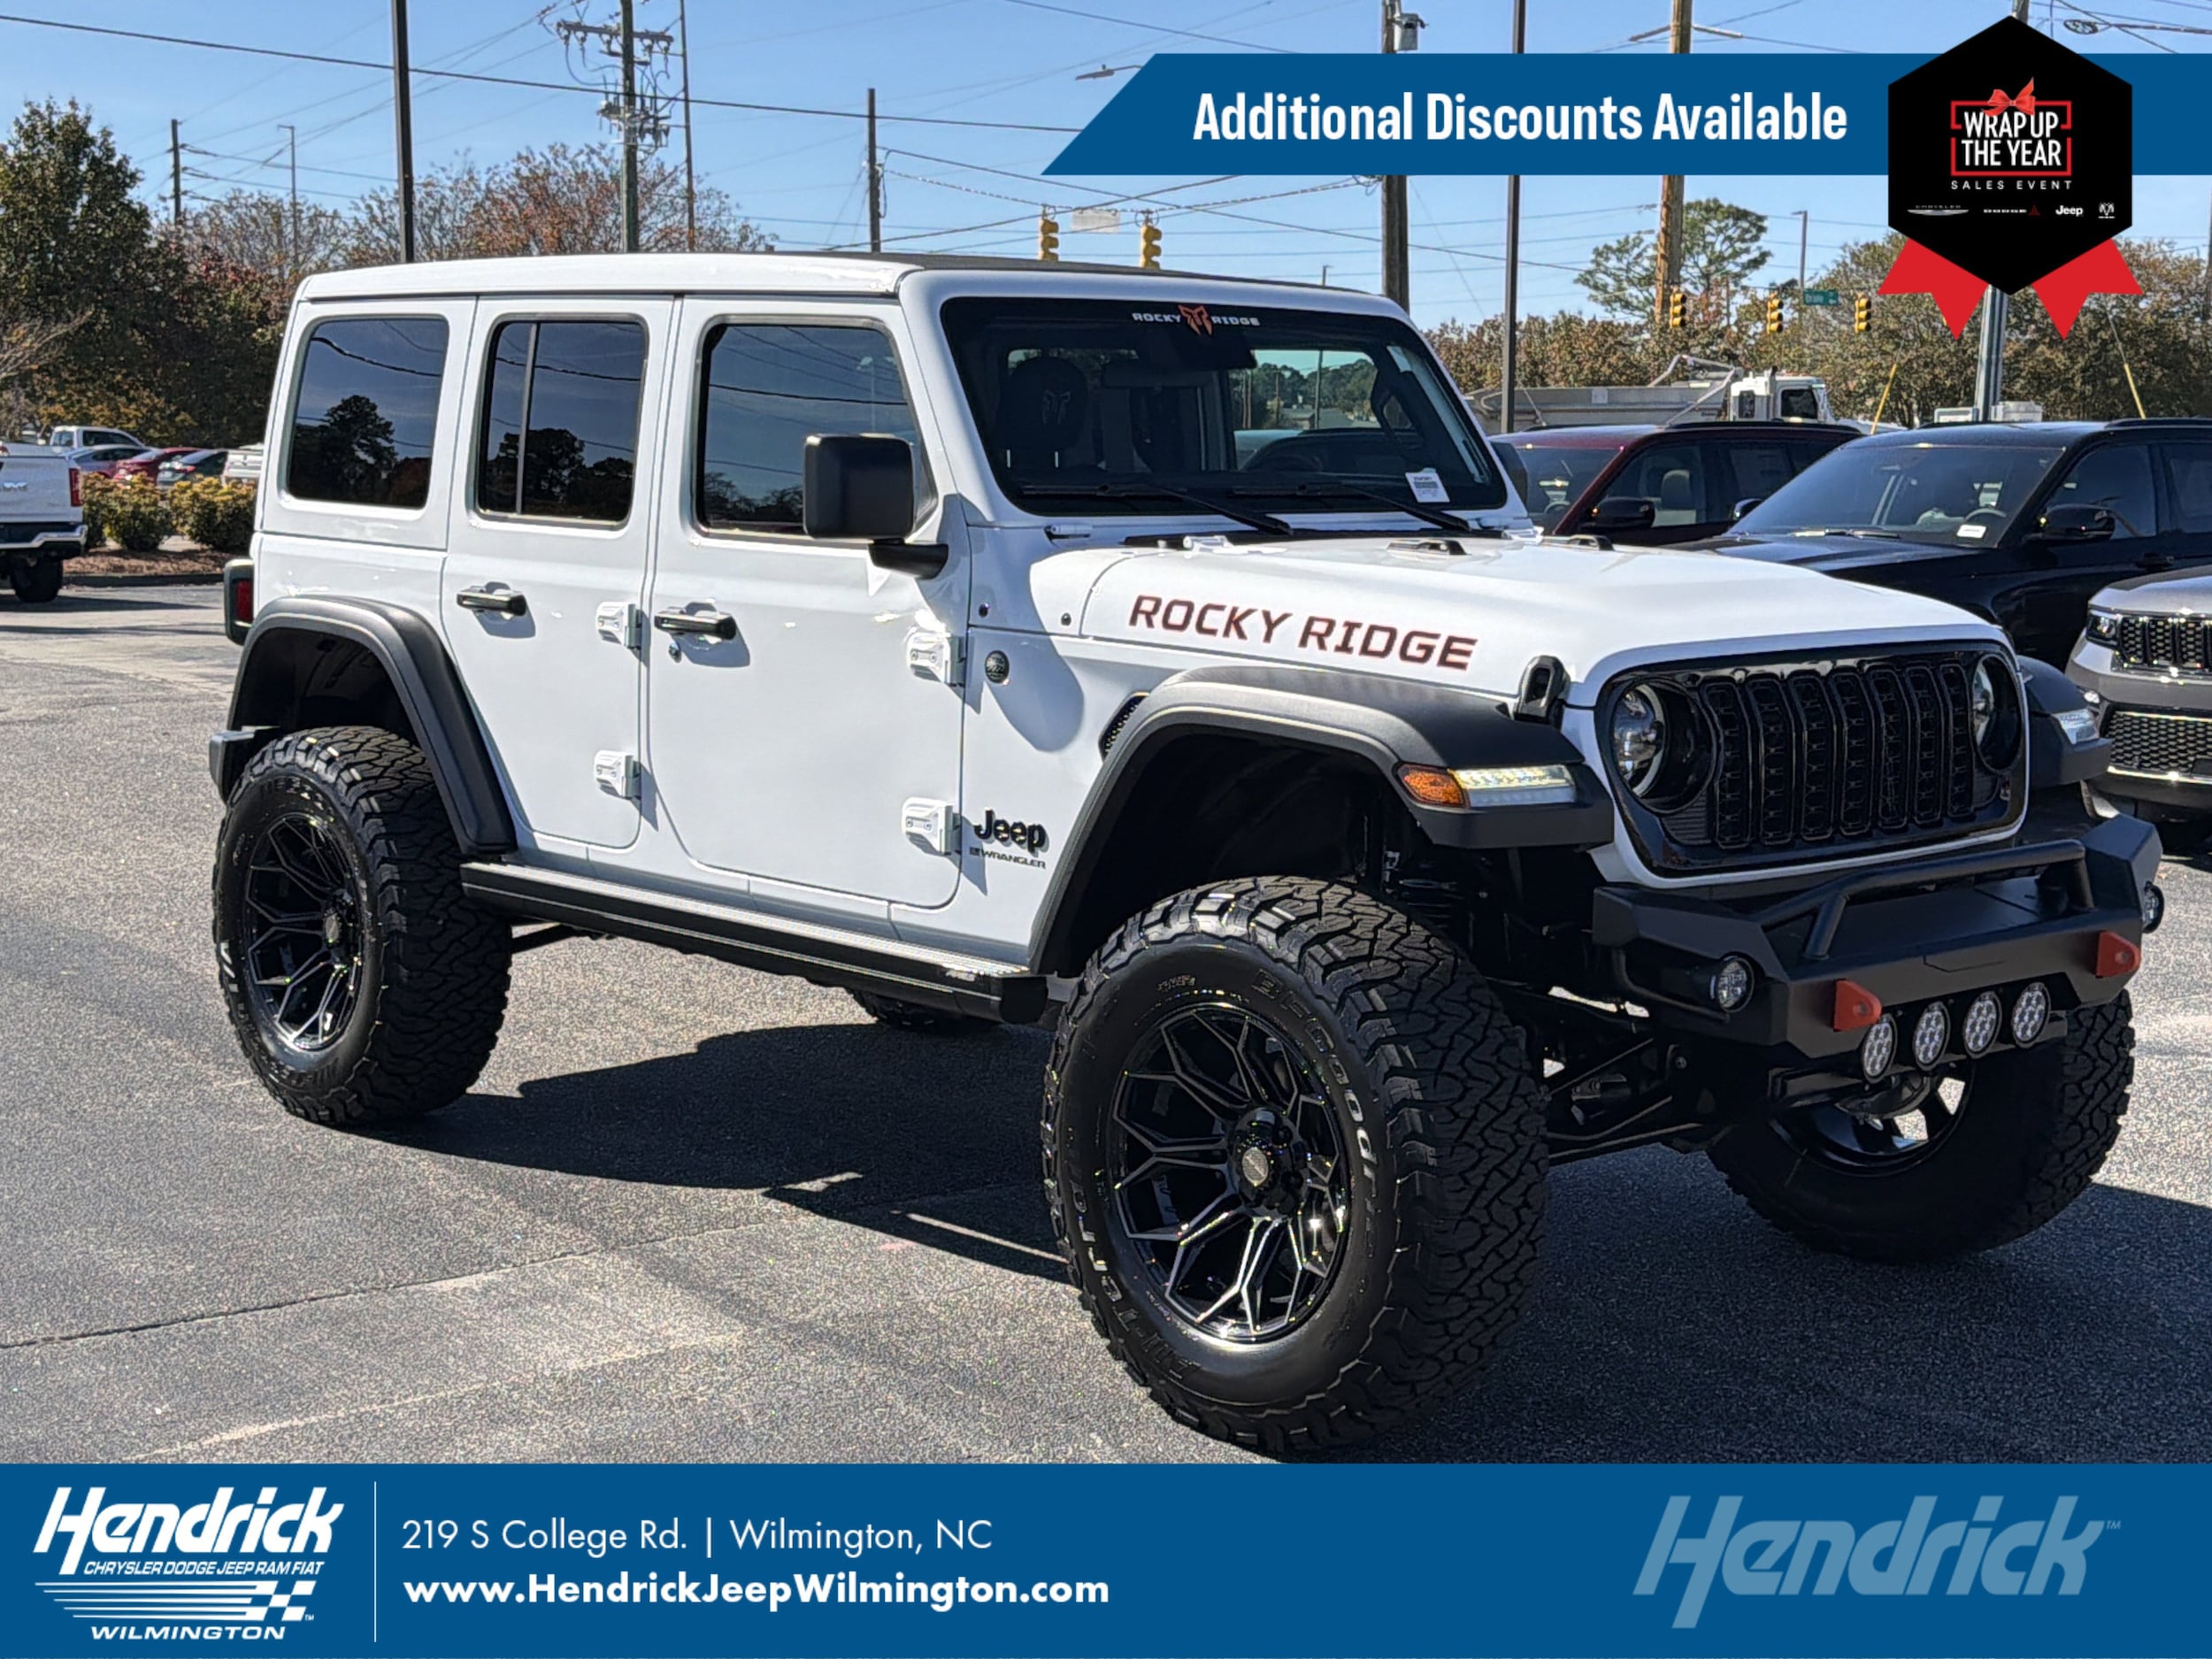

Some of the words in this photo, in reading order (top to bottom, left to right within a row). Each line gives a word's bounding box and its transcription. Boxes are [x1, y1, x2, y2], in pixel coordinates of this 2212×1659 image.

[1131, 312, 1182, 323] ROCKY
[1210, 315, 1261, 326] RIDGE
[1128, 594, 1294, 644] ROCKY
[1297, 615, 1479, 672] RIDGE
[972, 807, 1048, 855] Jeep
[981, 849, 1047, 870] WRANGLER
